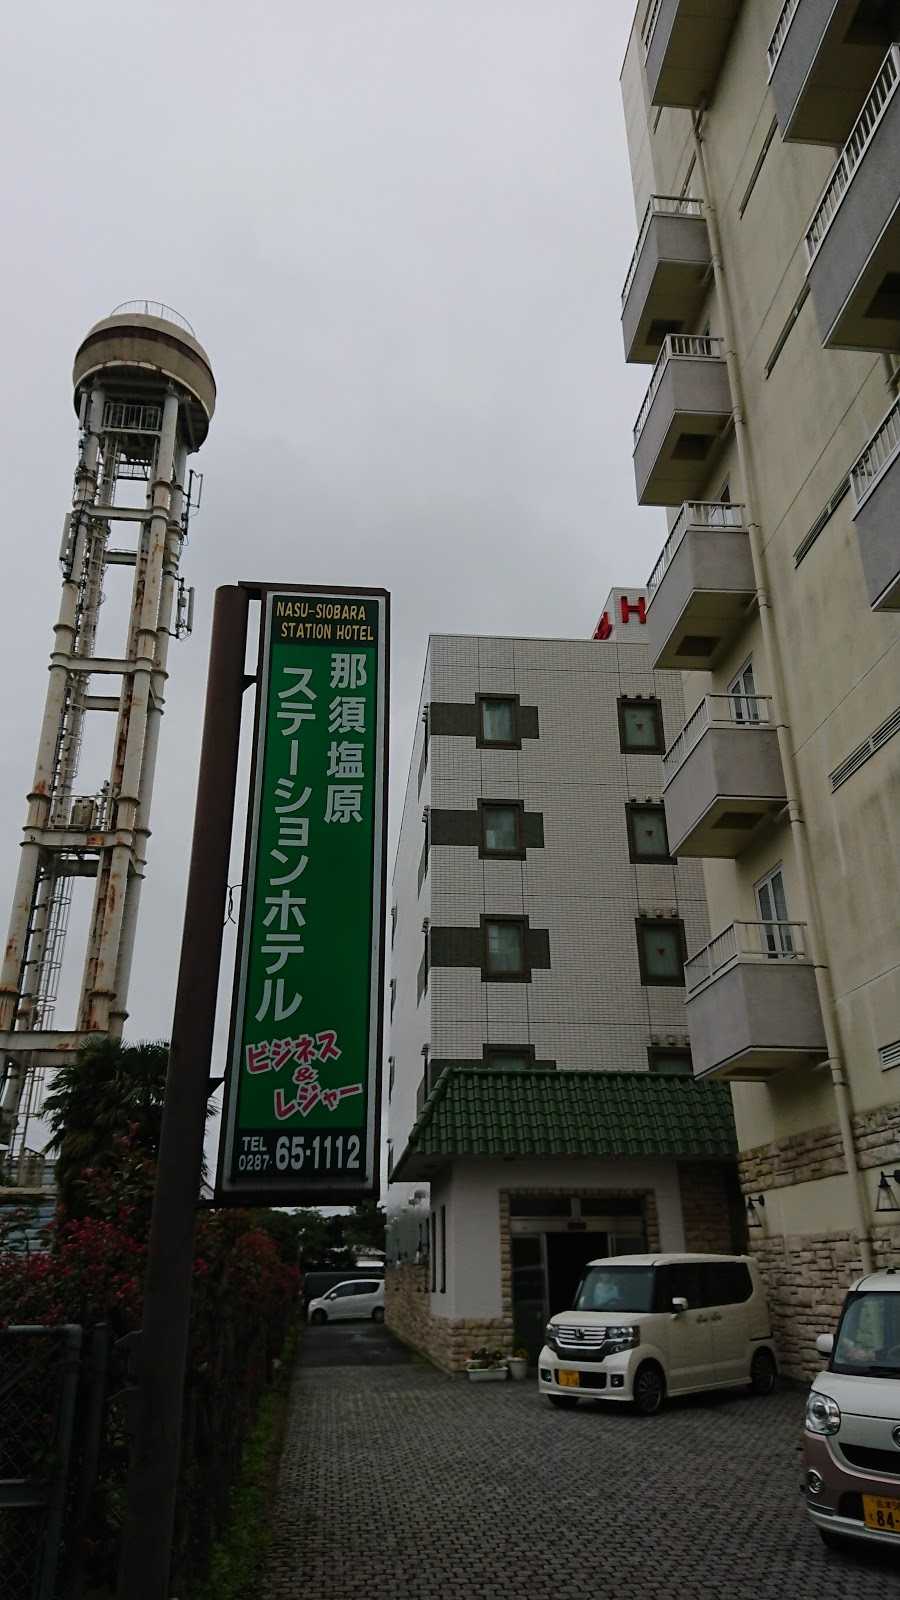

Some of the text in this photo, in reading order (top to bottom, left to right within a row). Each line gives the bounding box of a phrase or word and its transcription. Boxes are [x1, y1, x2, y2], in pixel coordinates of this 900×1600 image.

[276, 601, 367, 621] NASU-SIOBARA
[280, 622, 374, 641] STATION HOTEL
[323, 652, 368, 825] 那須塩原
[245, 1029, 342, 1075] ビジネス
[292, 1064, 319, 1085] &
[273, 1082, 364, 1121] レジャー
[241, 1136, 268, 1152] TEL
